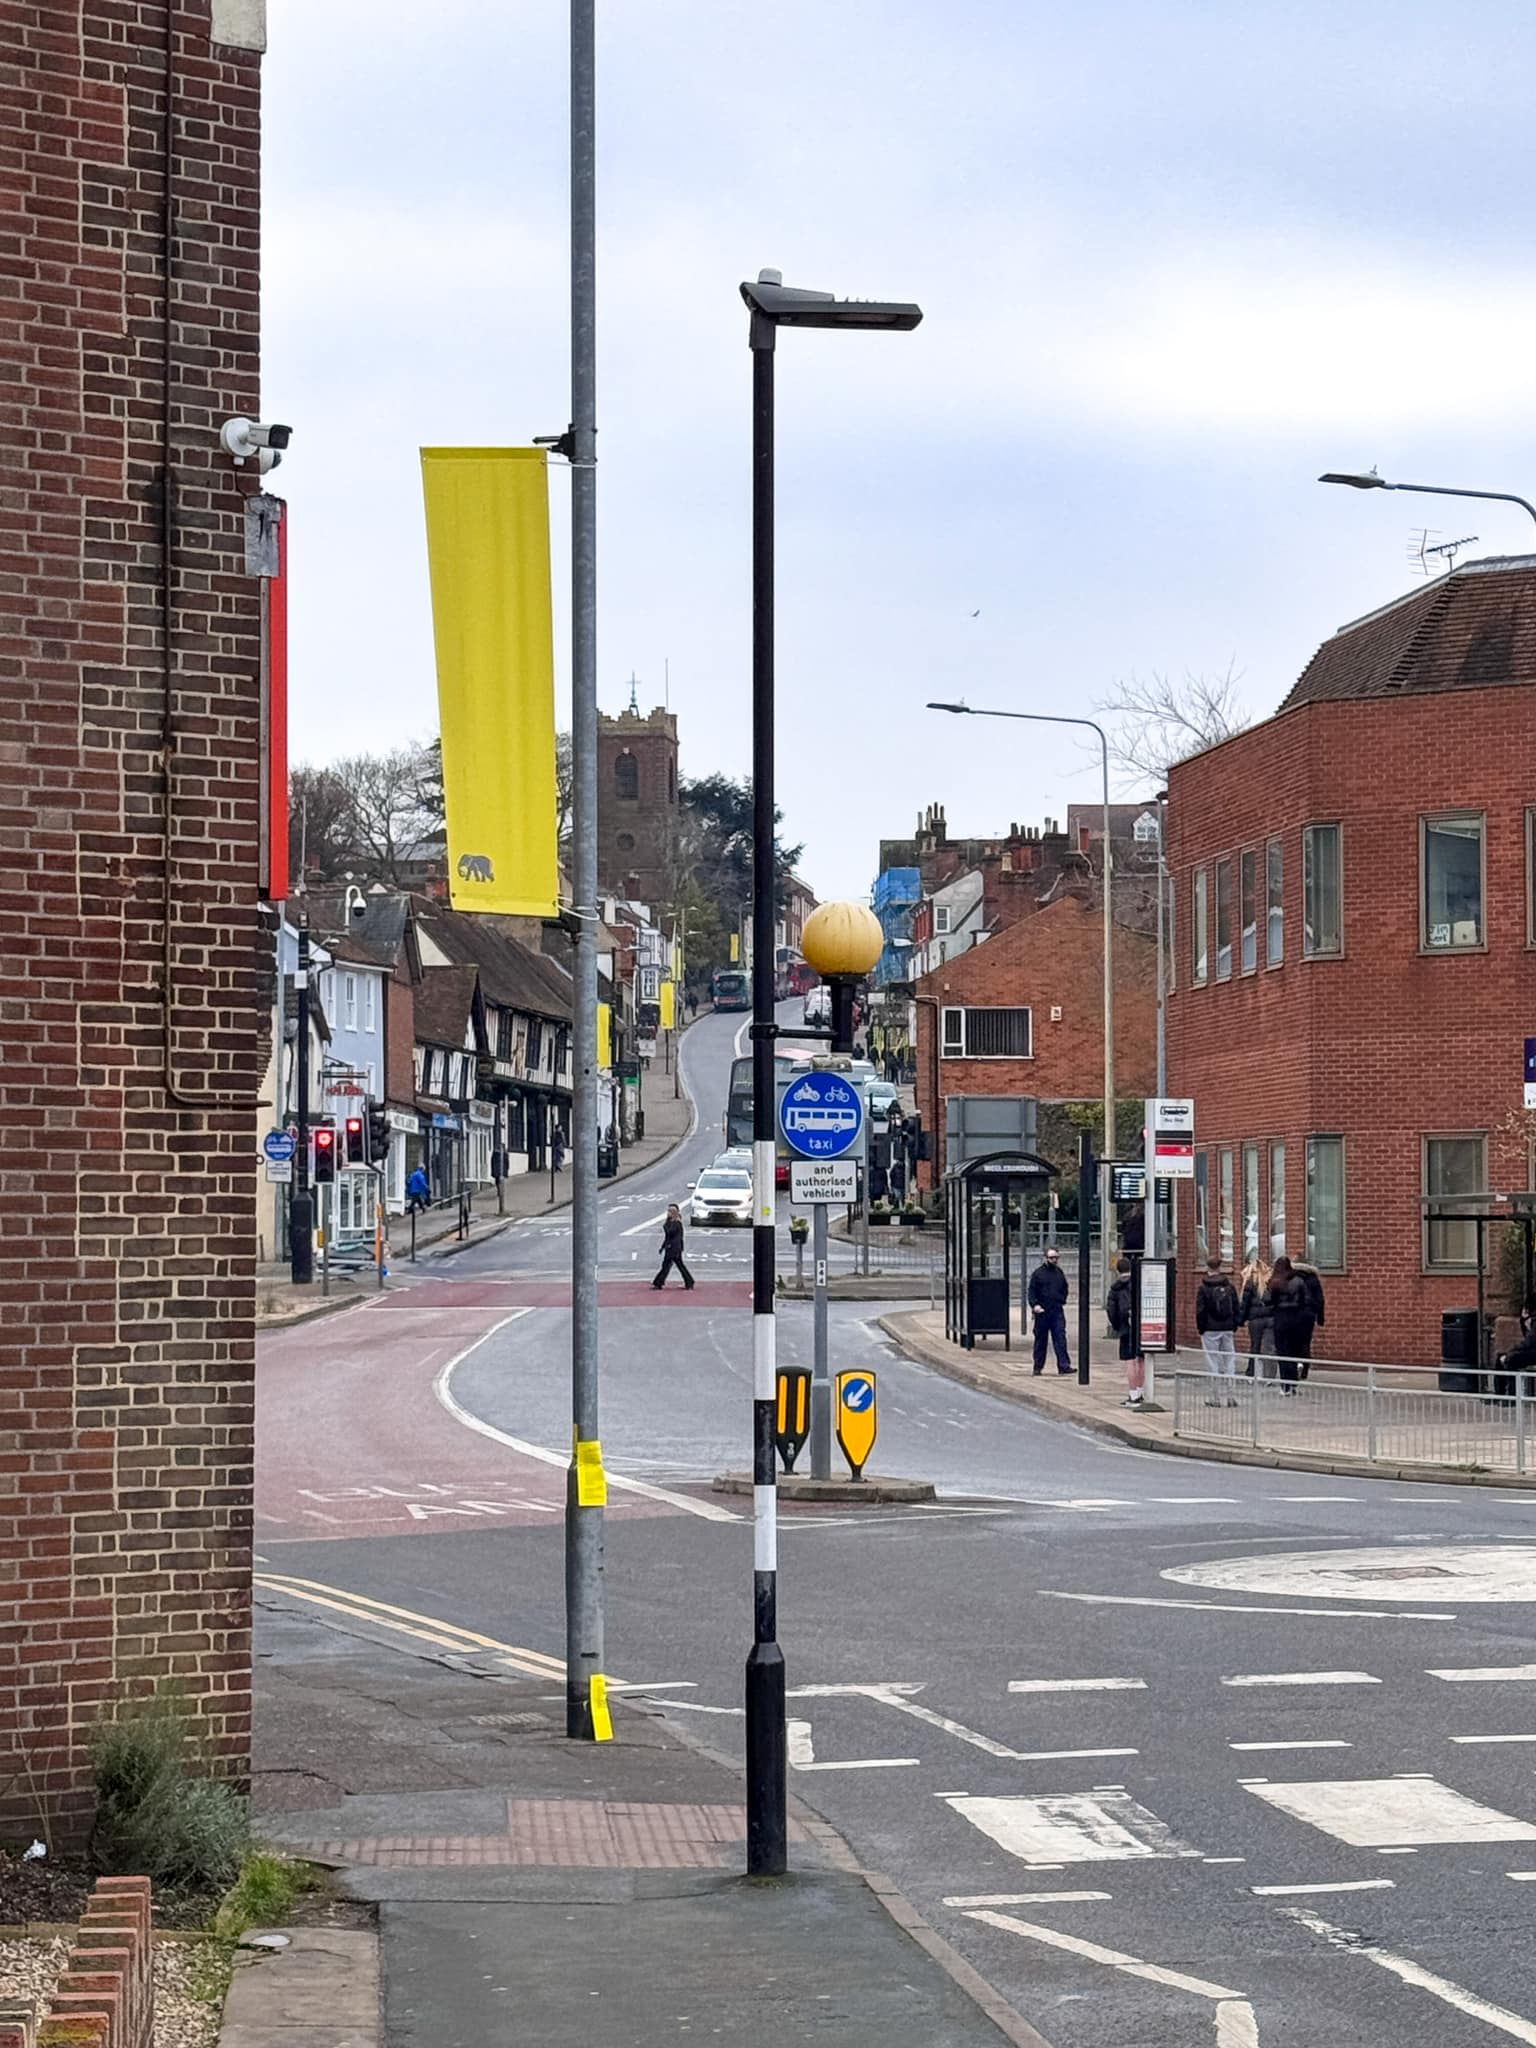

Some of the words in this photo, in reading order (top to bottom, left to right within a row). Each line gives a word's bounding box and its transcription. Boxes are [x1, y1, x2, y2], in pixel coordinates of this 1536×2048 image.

[808, 1137, 833, 1149] taxi
[814, 1164, 834, 1175] and
[795, 1176, 853, 1186] authorised
[802, 1188, 846, 1198] vehicles
[297, 1481, 526, 1501] BUS
